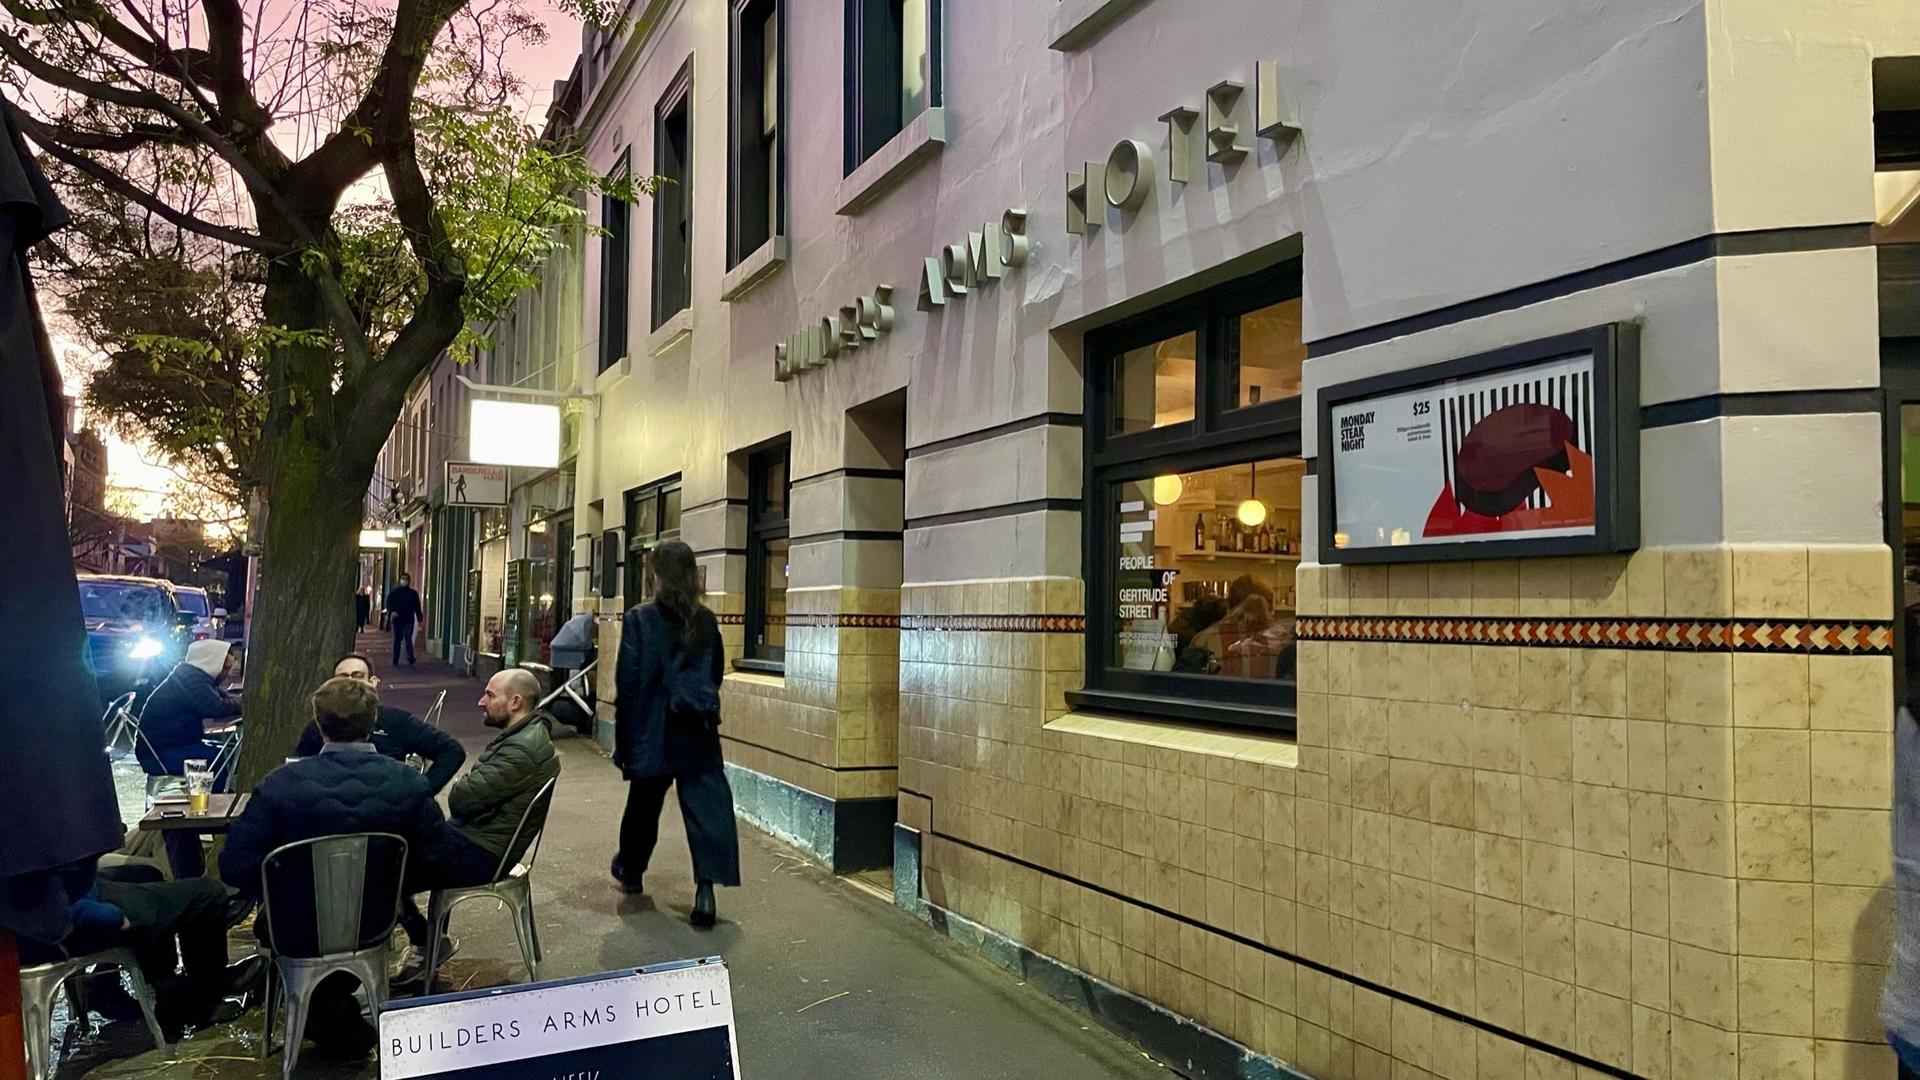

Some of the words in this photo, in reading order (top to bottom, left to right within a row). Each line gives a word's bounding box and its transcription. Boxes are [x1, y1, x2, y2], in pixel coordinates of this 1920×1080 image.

[774, 283, 895, 383] BUILDERS
[917, 208, 1029, 312] ARMS
[1066, 60, 1302, 235] HOTEL
[1413, 401, 1430, 416] $25
[1341, 411, 1375, 428] MONDAY
[1340, 426, 1365, 440] STEAK
[1341, 438, 1365, 452] NIGHT
[1119, 556, 1154, 570] PEOPLE
[1162, 571, 1176, 585] OF
[1119, 588, 1168, 603] GERTRUDE
[1119, 605, 1153, 619] STREET
[392, 1019, 521, 1057] BUILDERS
[543, 1005, 617, 1034] ARMS
[636, 989, 721, 1019] HOTEL
